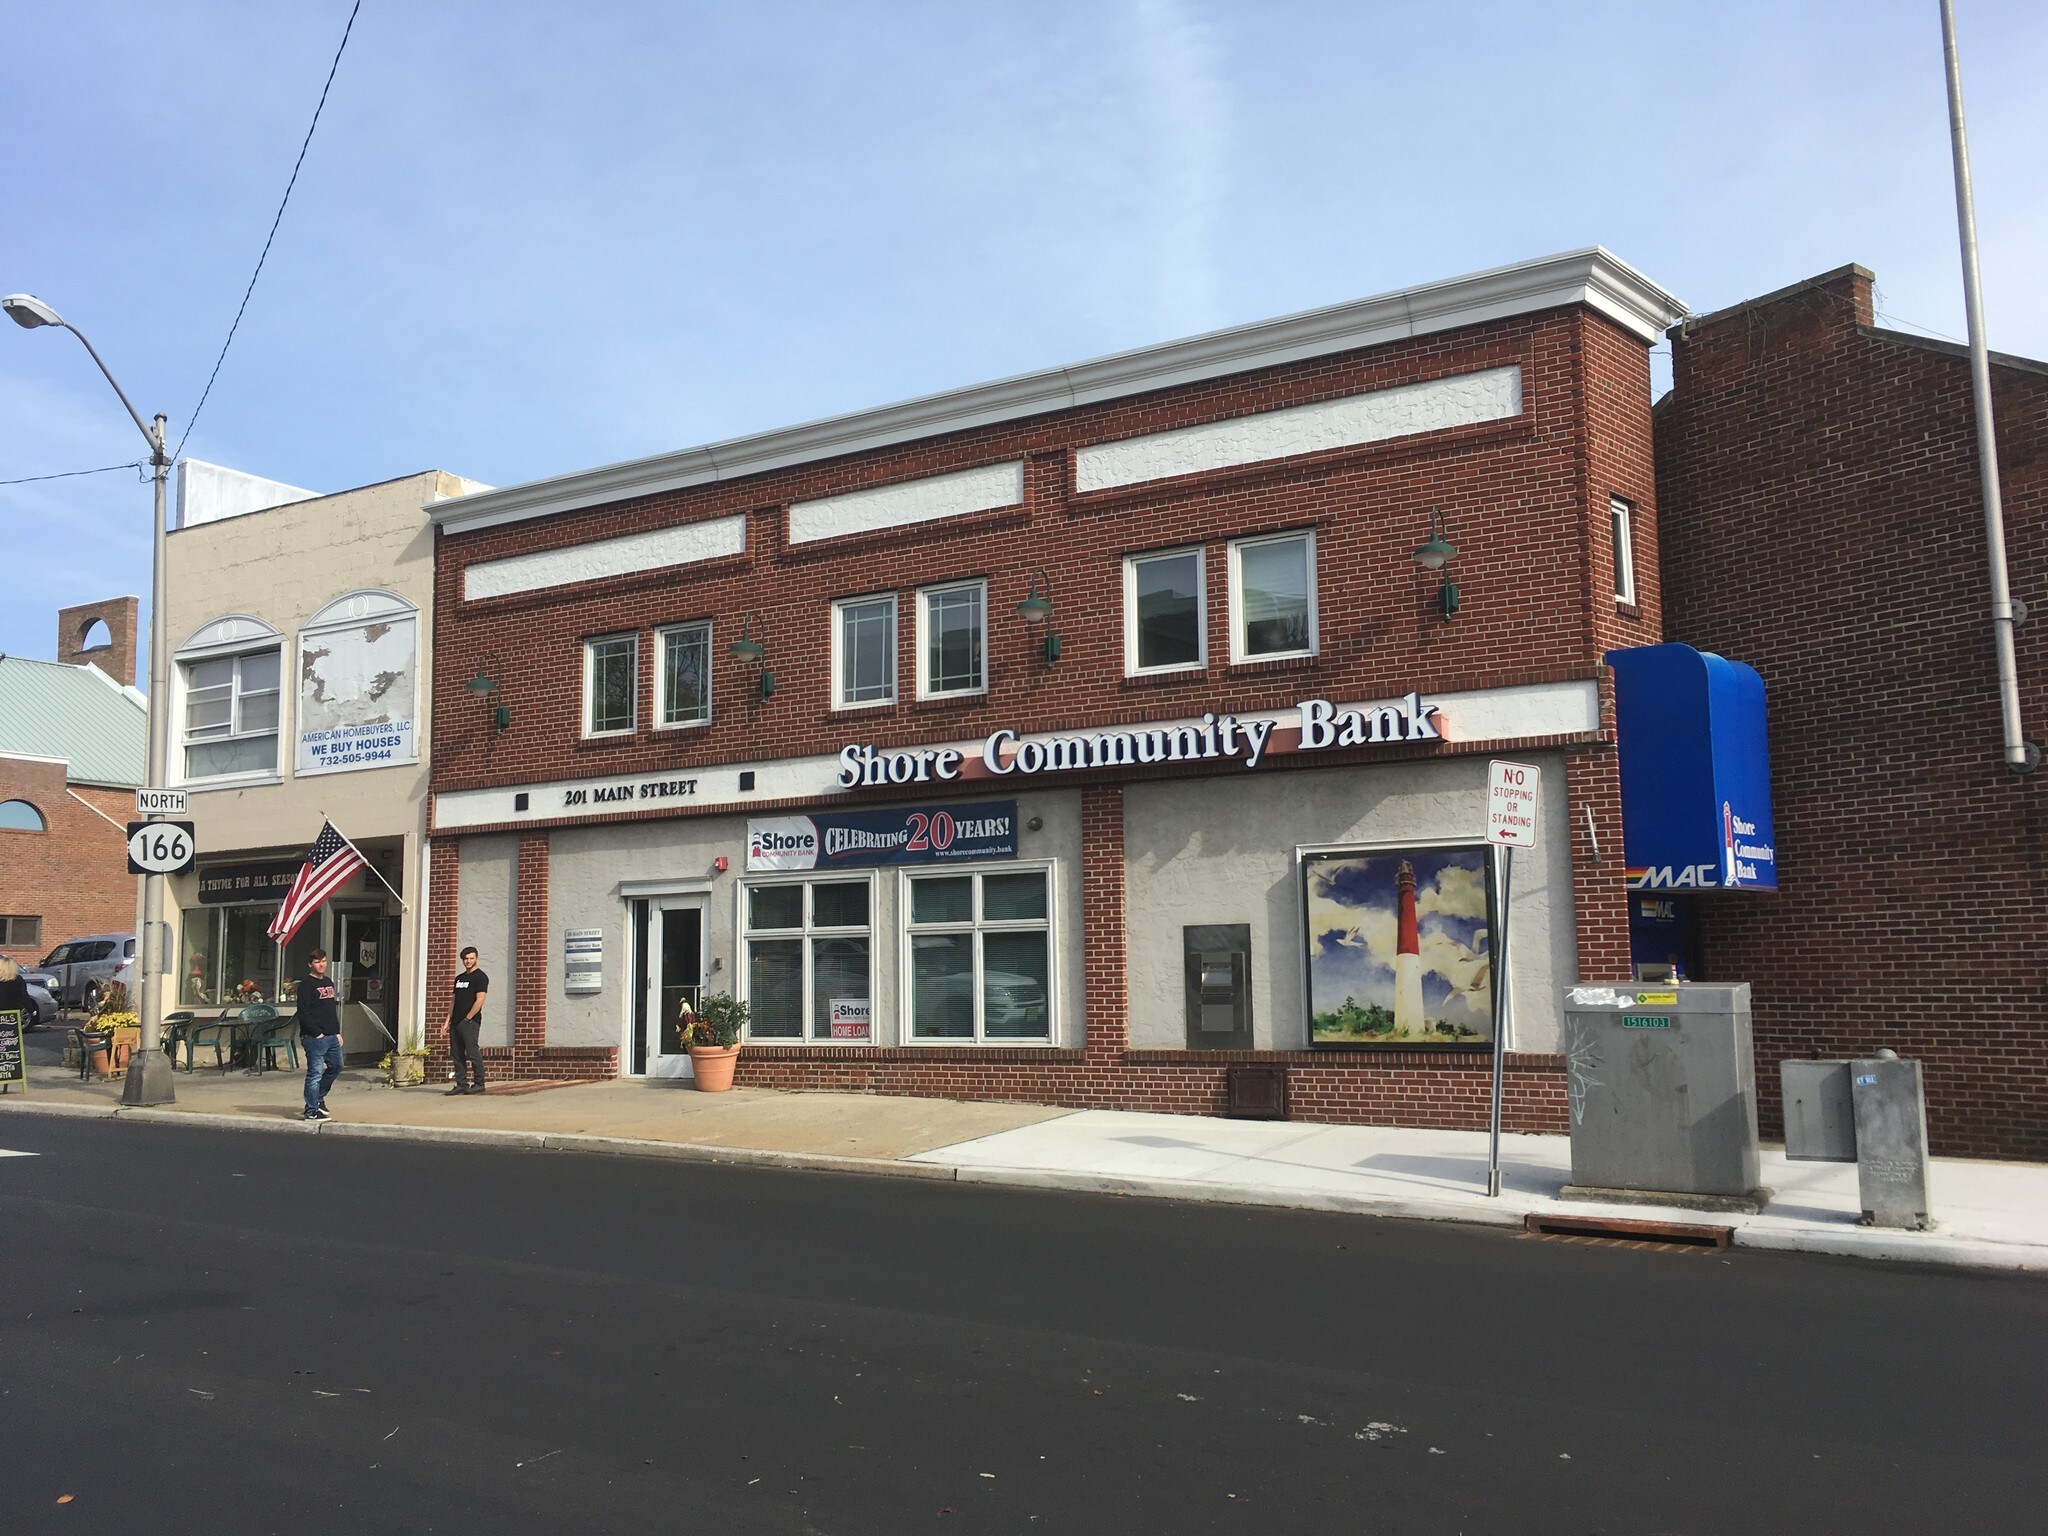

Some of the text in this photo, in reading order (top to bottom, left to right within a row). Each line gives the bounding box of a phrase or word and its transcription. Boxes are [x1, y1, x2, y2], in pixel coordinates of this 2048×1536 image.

[302, 729, 341, 743] AMERICAN
[343, 724, 395, 738] HOMEBUYERS,
[838, 692, 1440, 789] Shore Community Bank
[311, 735, 401, 756] WE BUY HOUSES
[320, 749, 391, 766] 732-505-9944
[1504, 768, 1525, 785] NO
[140, 793, 184, 809] NORTH
[565, 779, 697, 805] 201 MAIN STREET
[1494, 786, 1533, 801] STOPPING
[1506, 801, 1518, 812] OR
[1492, 813, 1531, 828] STANDING
[1733, 815, 1756, 836] Shore
[762, 832, 814, 850] Shore
[825, 811, 1010, 856] CELEBRATING 20 YEARS!
[140, 833, 186, 861] 166
[761, 850, 797, 858] COMMUNITY
[1734, 839, 1774, 865] Community
[1630, 864, 1719, 888] MAC
[1736, 860, 1758, 879] Bank
[207, 878, 232, 891] THYME
[235, 876, 250, 889] FOR
[253, 875, 269, 887] ALL
[272, 873, 298, 886] SEASO
[840, 1005, 869, 1016] Shore
[833, 1025, 852, 1037] HOME
[1627, 1017, 1666, 1027] 1516103
